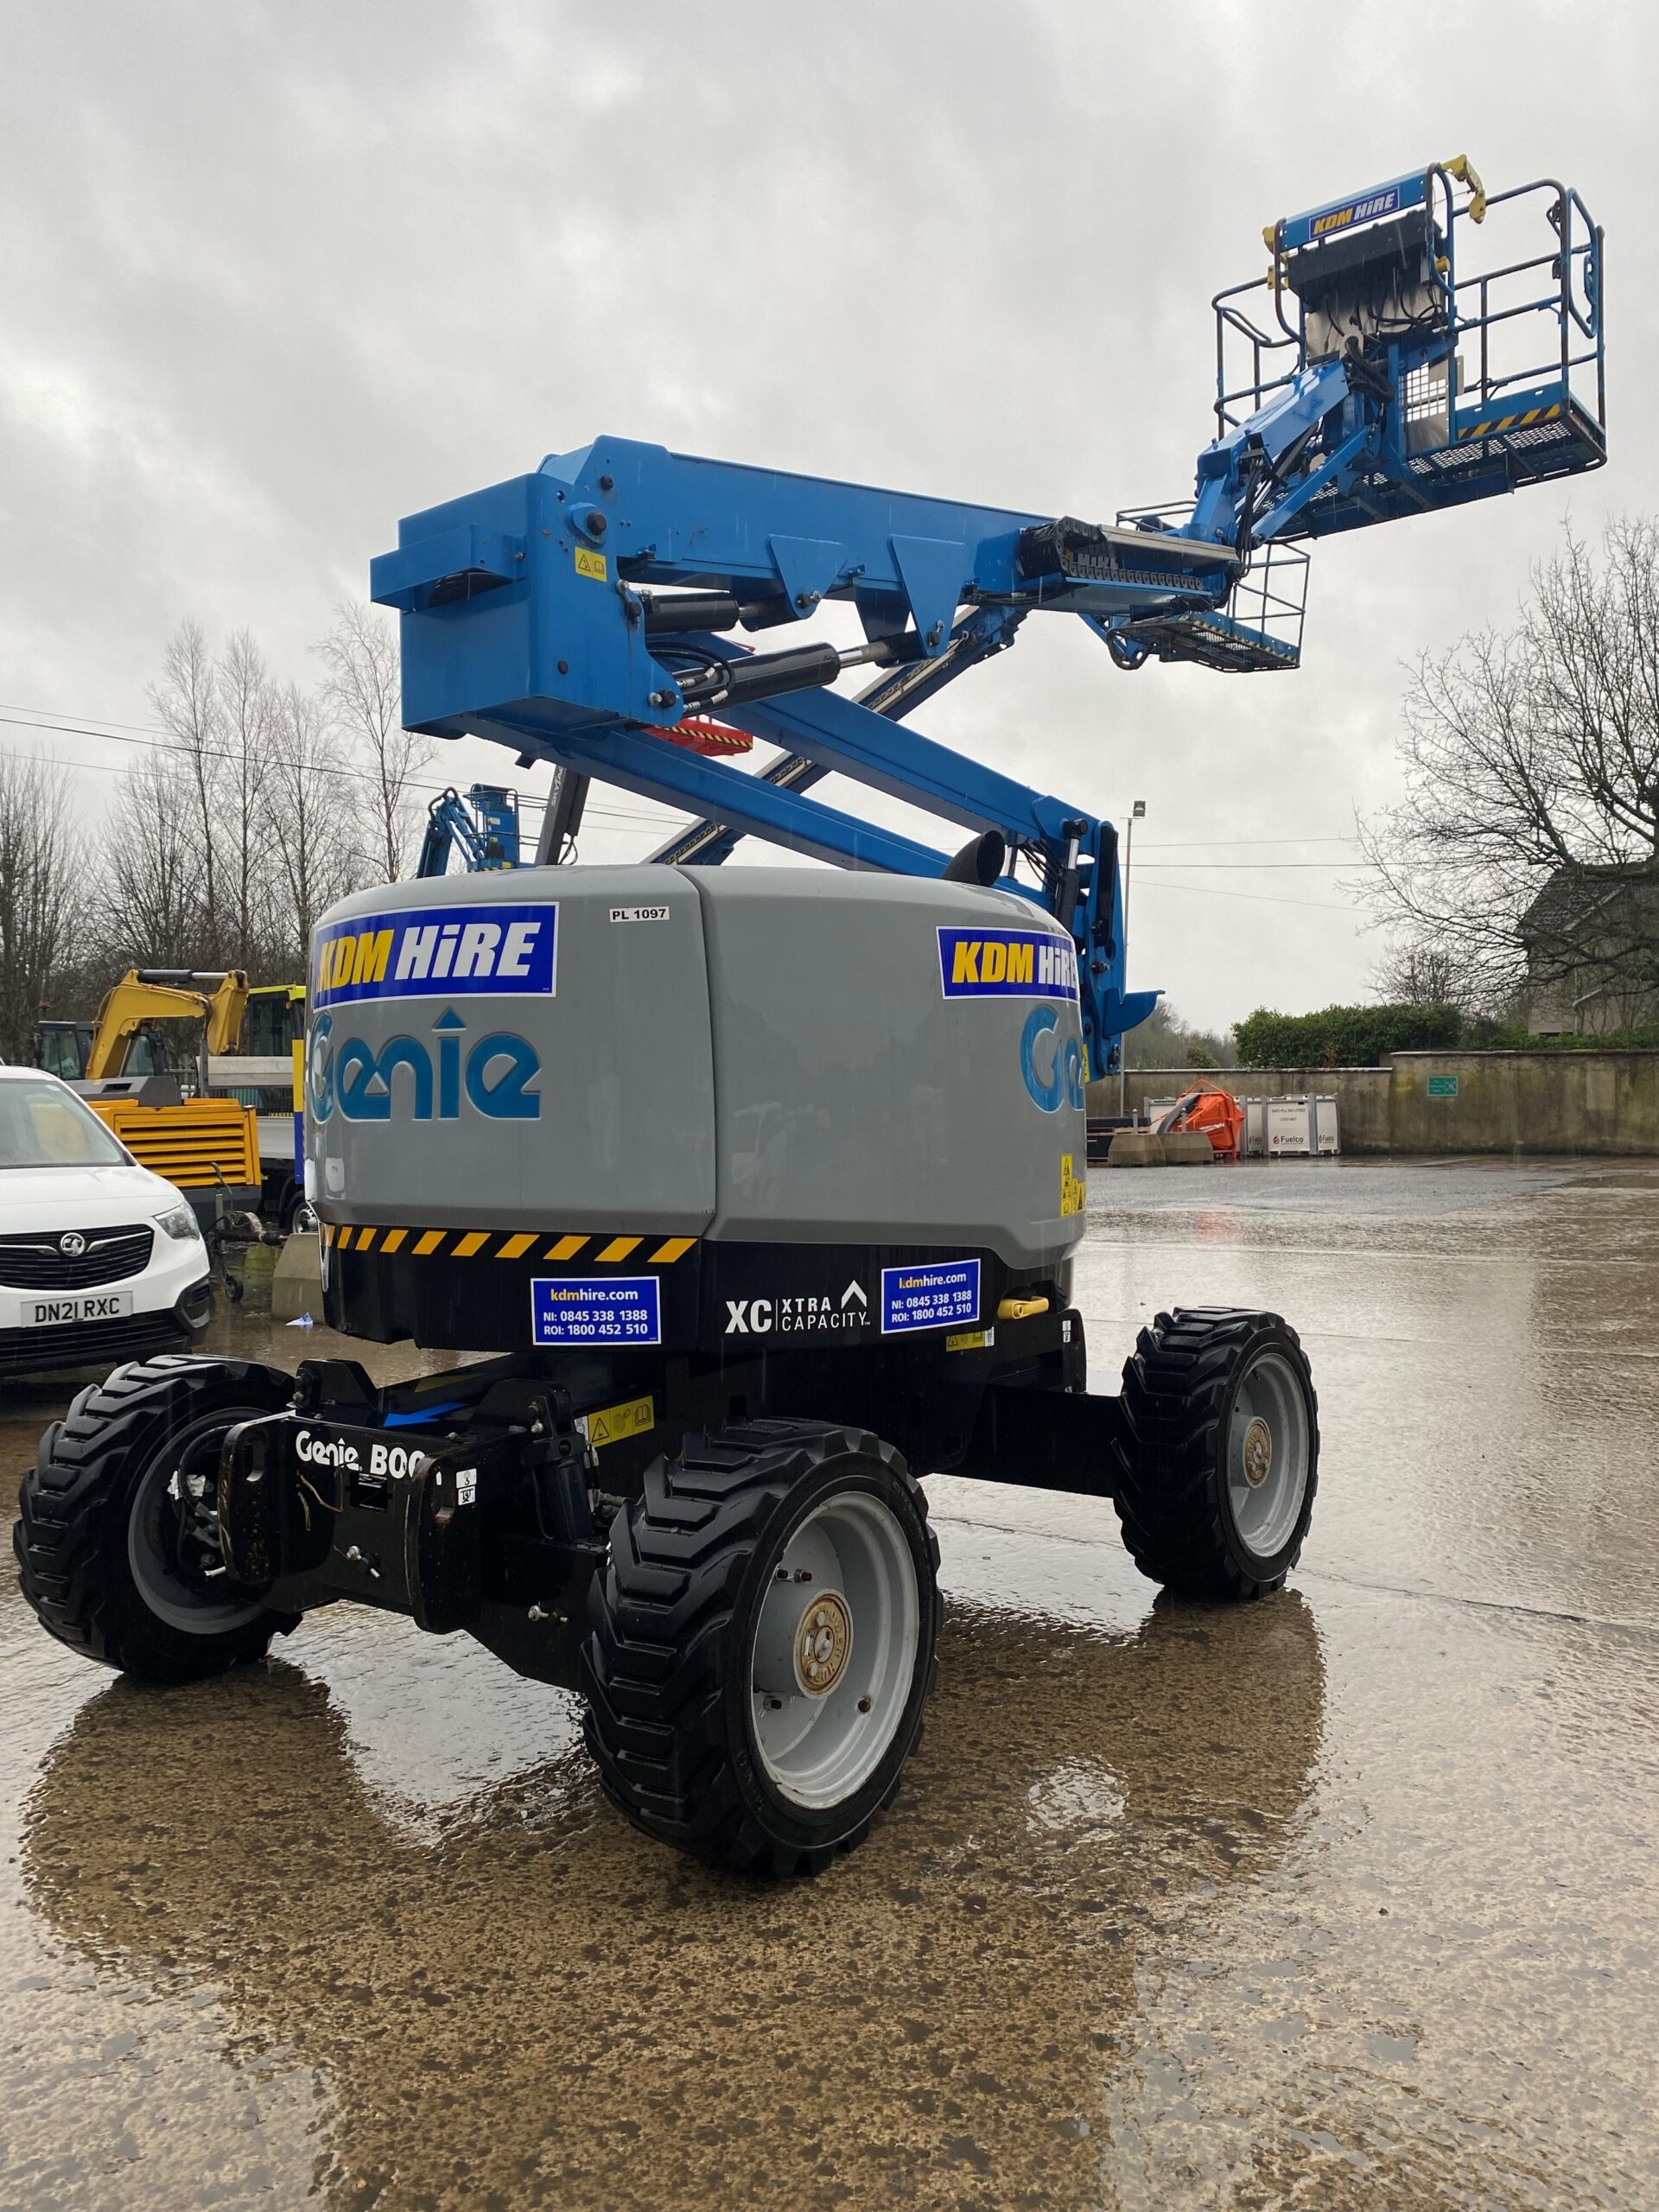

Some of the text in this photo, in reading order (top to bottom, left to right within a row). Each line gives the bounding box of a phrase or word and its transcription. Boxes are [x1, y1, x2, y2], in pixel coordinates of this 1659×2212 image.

[1313, 207, 1353, 235] KDM
[550, 766, 564, 807] SKYJAC
[612, 908, 666, 920] PL 1097
[318, 929, 395, 993] KDM
[952, 941, 1033, 983] KDM
[309, 1006, 542, 1123] Genie
[550, 1288, 639, 1301] kdmhire.com
[781, 1297, 832, 1313] XTRA
[892, 1289, 972, 1310] NI: 0845 338 1388
[35, 1297, 120, 1323] DN21 RXC
[543, 1309, 648, 1322] NI: 0845 338 1388
[724, 1299, 772, 1334] XC
[781, 1311, 867, 1332] CAPACITY
[891, 1302, 972, 1323] ROI: 1800 452 510
[543, 1323, 648, 1336] ROI: 1800 452 510
[296, 1430, 427, 1480] Genie BOO
